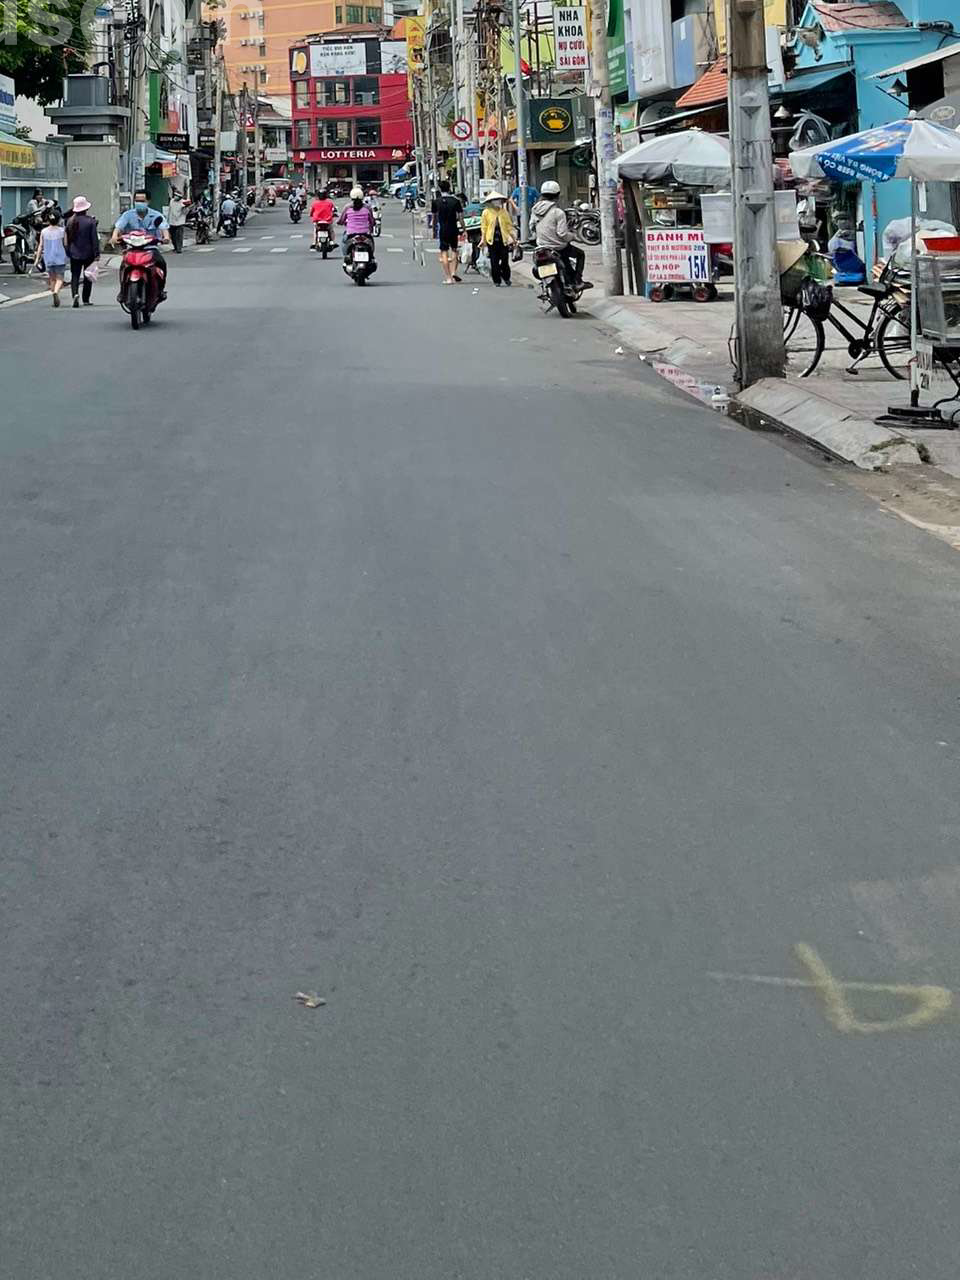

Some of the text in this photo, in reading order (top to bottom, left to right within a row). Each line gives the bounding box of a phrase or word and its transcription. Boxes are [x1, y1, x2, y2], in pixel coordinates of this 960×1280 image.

[559, 10, 579, 22] NHA
[558, 25, 583, 37] KHOA
[321, 150, 376, 159] LOTTERIA
[688, 255, 707, 279] 15K
